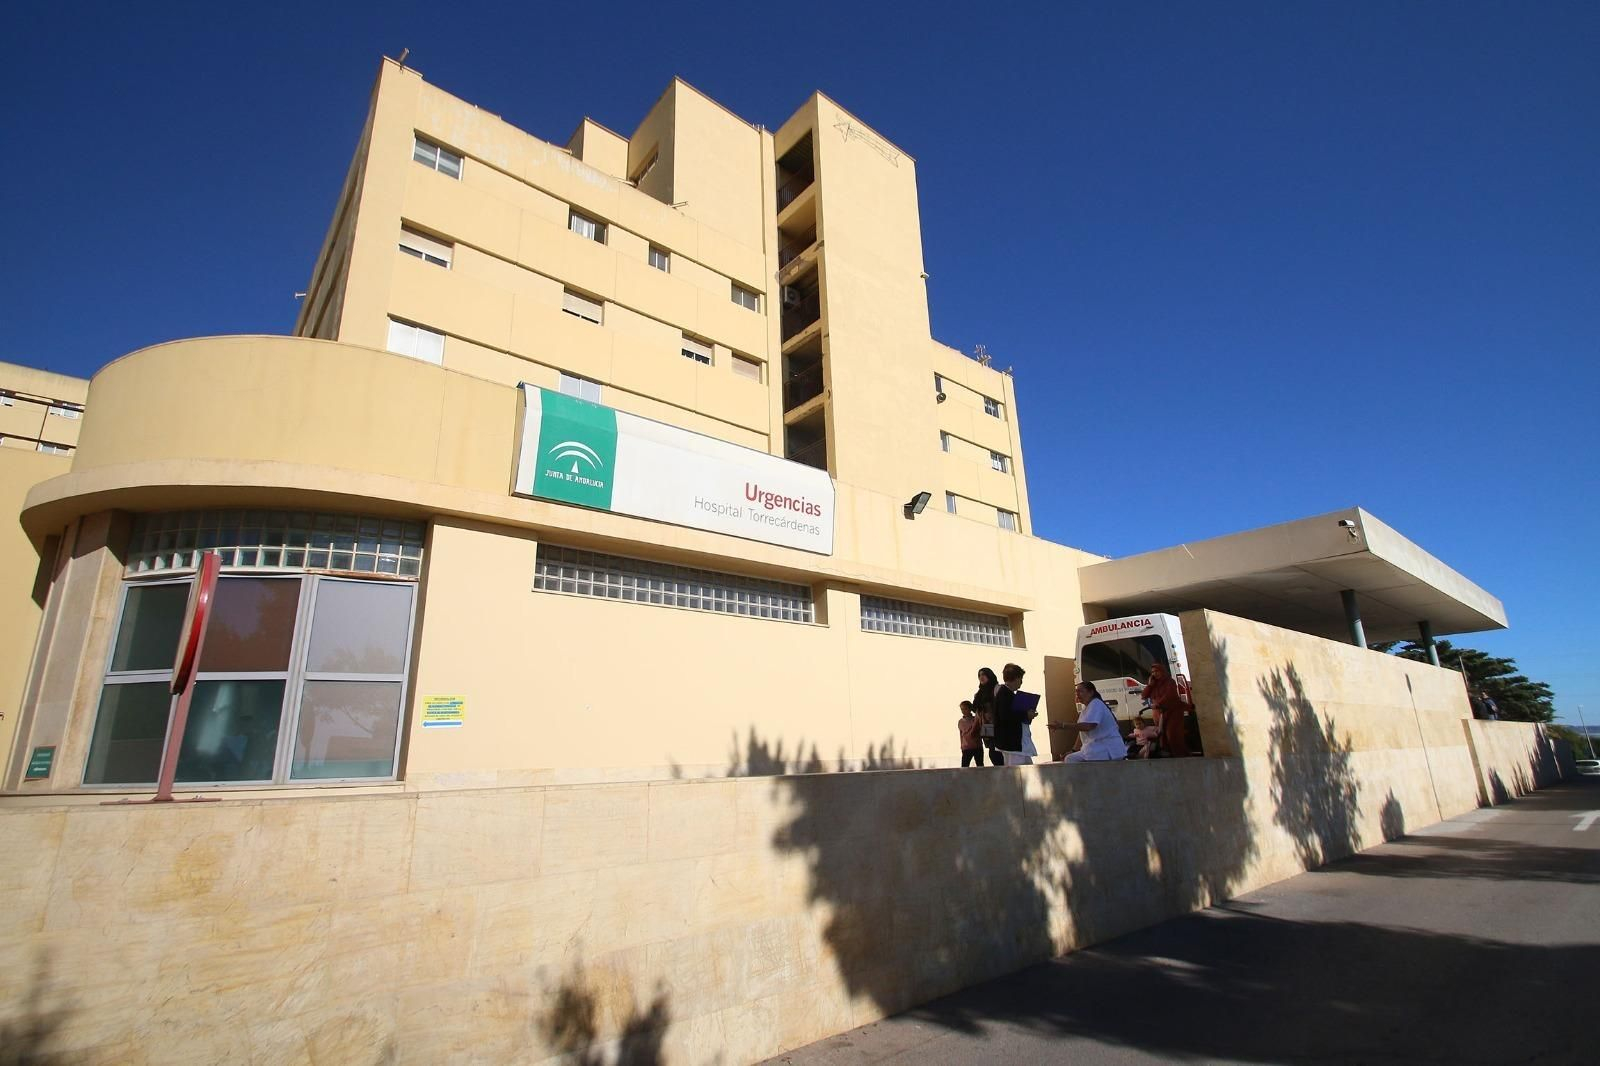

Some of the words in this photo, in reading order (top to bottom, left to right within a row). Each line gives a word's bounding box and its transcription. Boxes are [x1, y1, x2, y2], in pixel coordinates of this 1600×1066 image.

[545, 469, 564, 479] JUNTA
[565, 473, 573, 482] DE
[745, 482, 822, 517] Urgencias
[694, 495, 743, 519] Hospital
[748, 507, 821, 536] Torrecárdenas
[1090, 618, 1152, 636] AMBULANCIA
